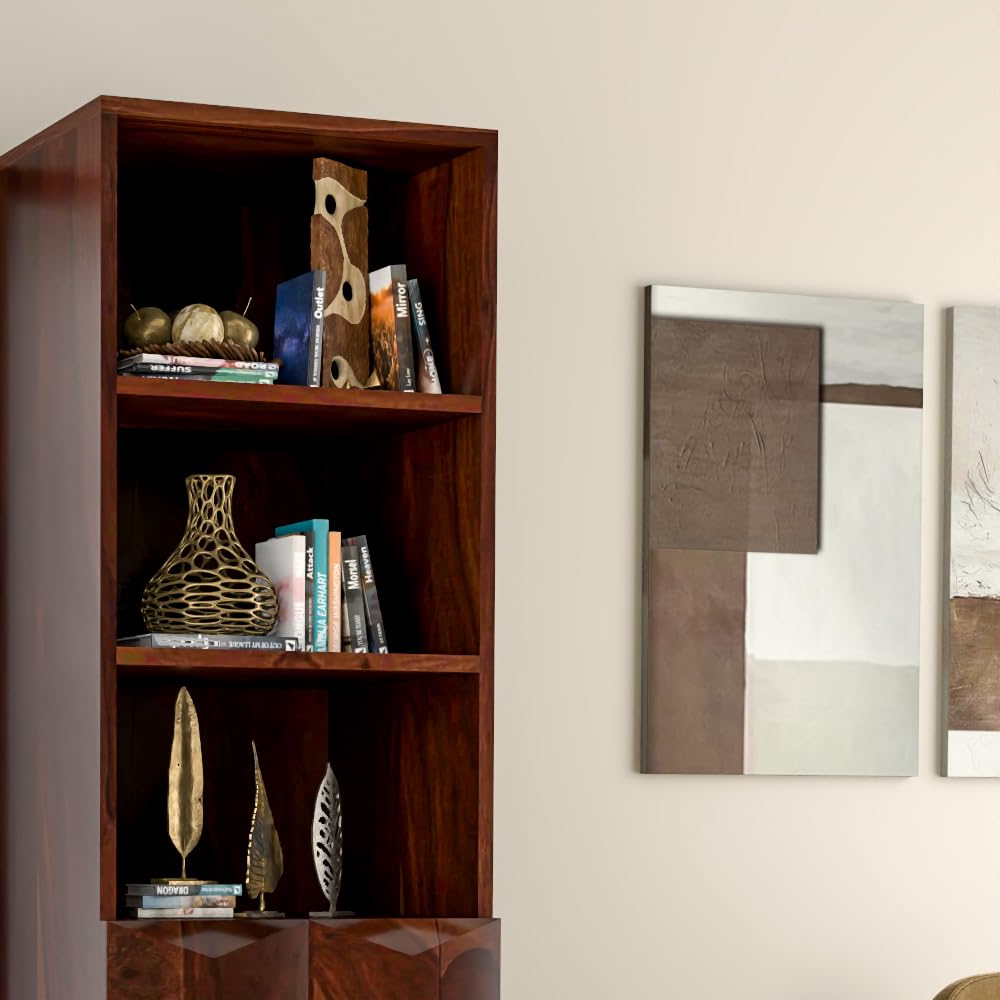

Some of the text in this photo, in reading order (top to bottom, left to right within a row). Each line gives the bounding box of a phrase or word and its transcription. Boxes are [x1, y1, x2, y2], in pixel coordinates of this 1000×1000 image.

[314, 287, 326, 319] Outlet
[395, 283, 408, 318] Mirror
[415, 302, 426, 326] SING
[150, 364, 193, 373] SUFFER
[306, 547, 314, 580] Attack
[344, 559, 361, 590] Morsel
[360, 546, 374, 584] Heaven
[317, 572, 328, 617] EARHART
[156, 886, 189, 895] DRAGON
